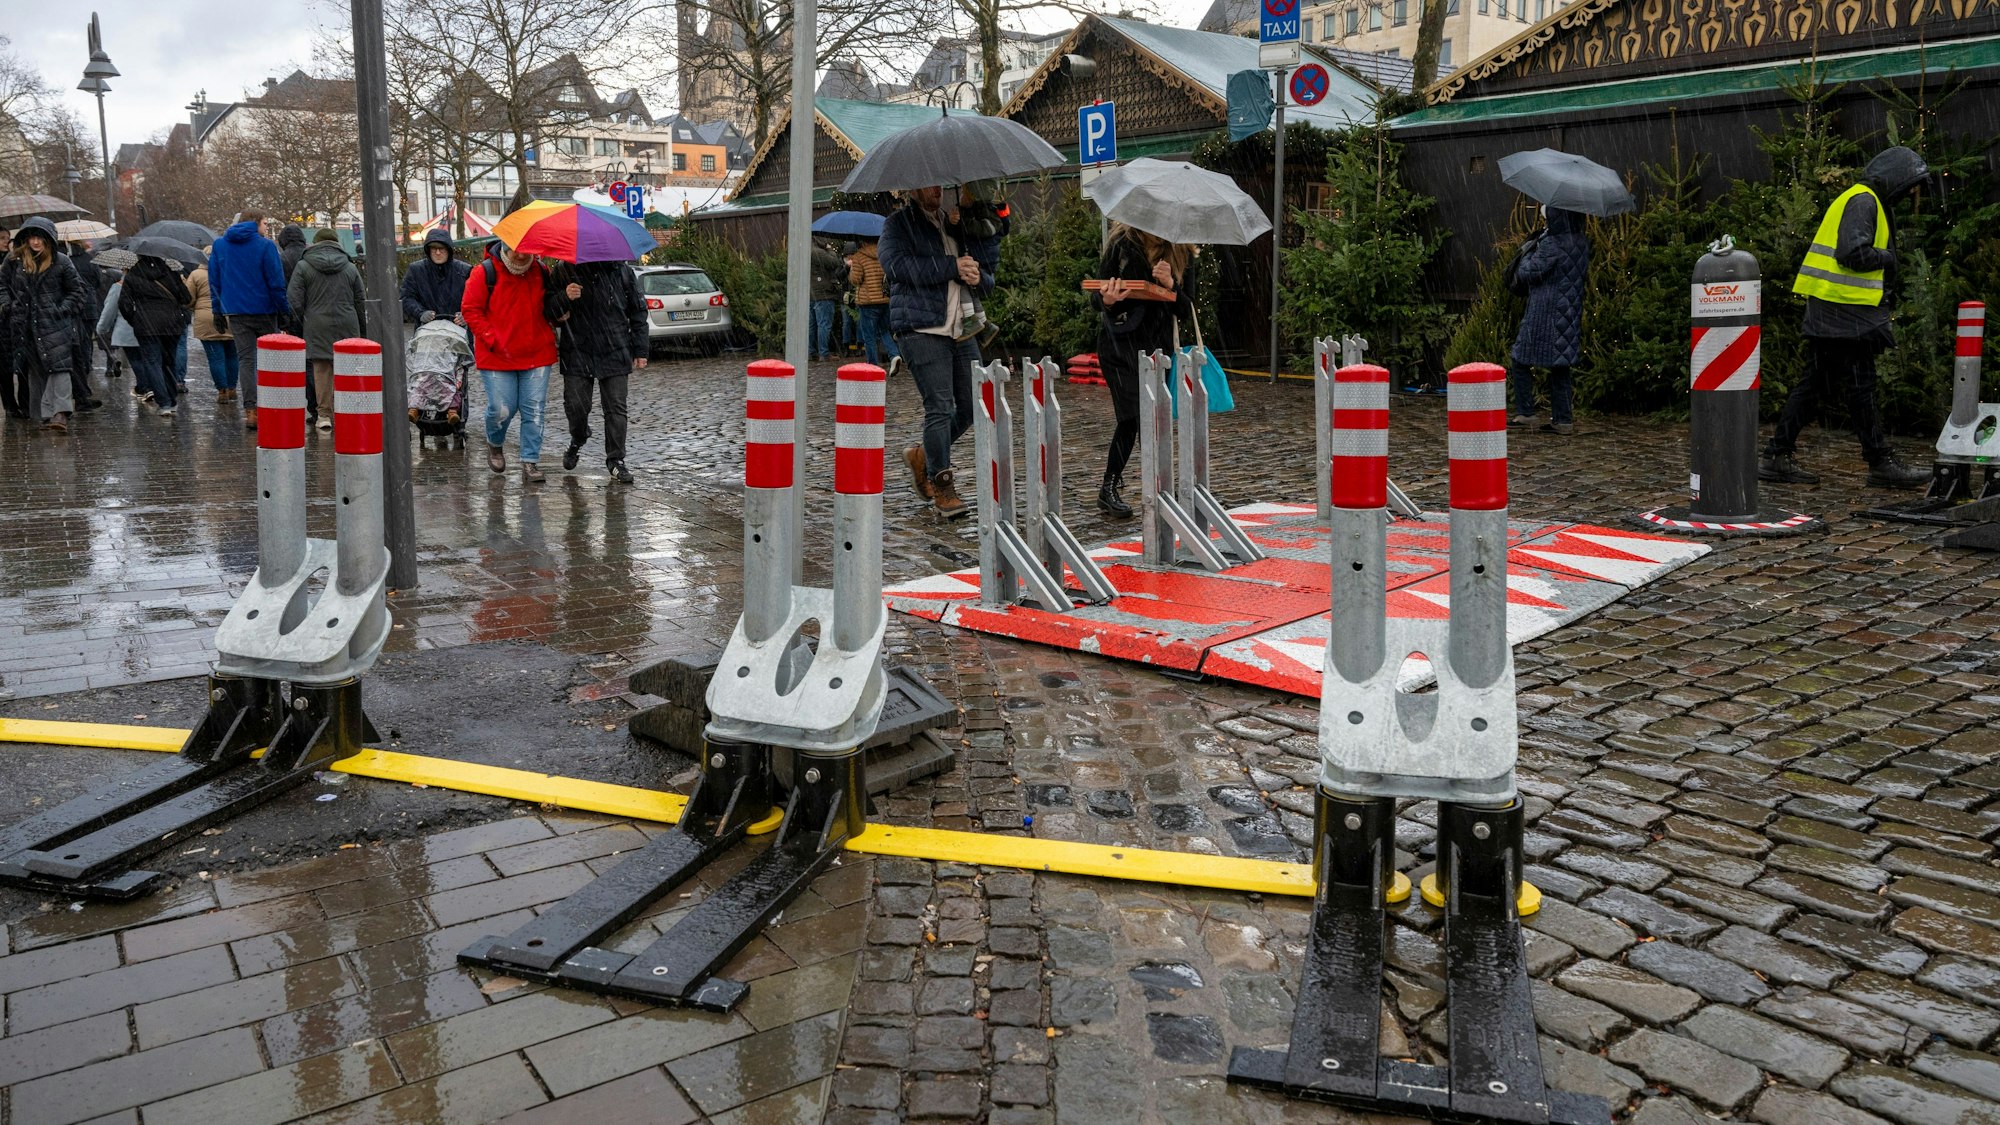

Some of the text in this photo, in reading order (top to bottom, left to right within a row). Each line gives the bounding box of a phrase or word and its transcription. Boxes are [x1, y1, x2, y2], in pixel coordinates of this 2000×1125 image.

[1264, 20, 1296, 37] TAXI
[1087, 112, 1106, 157] P
[629, 190, 640, 215] P
[1699, 295, 1746, 303] VOLKMANN
